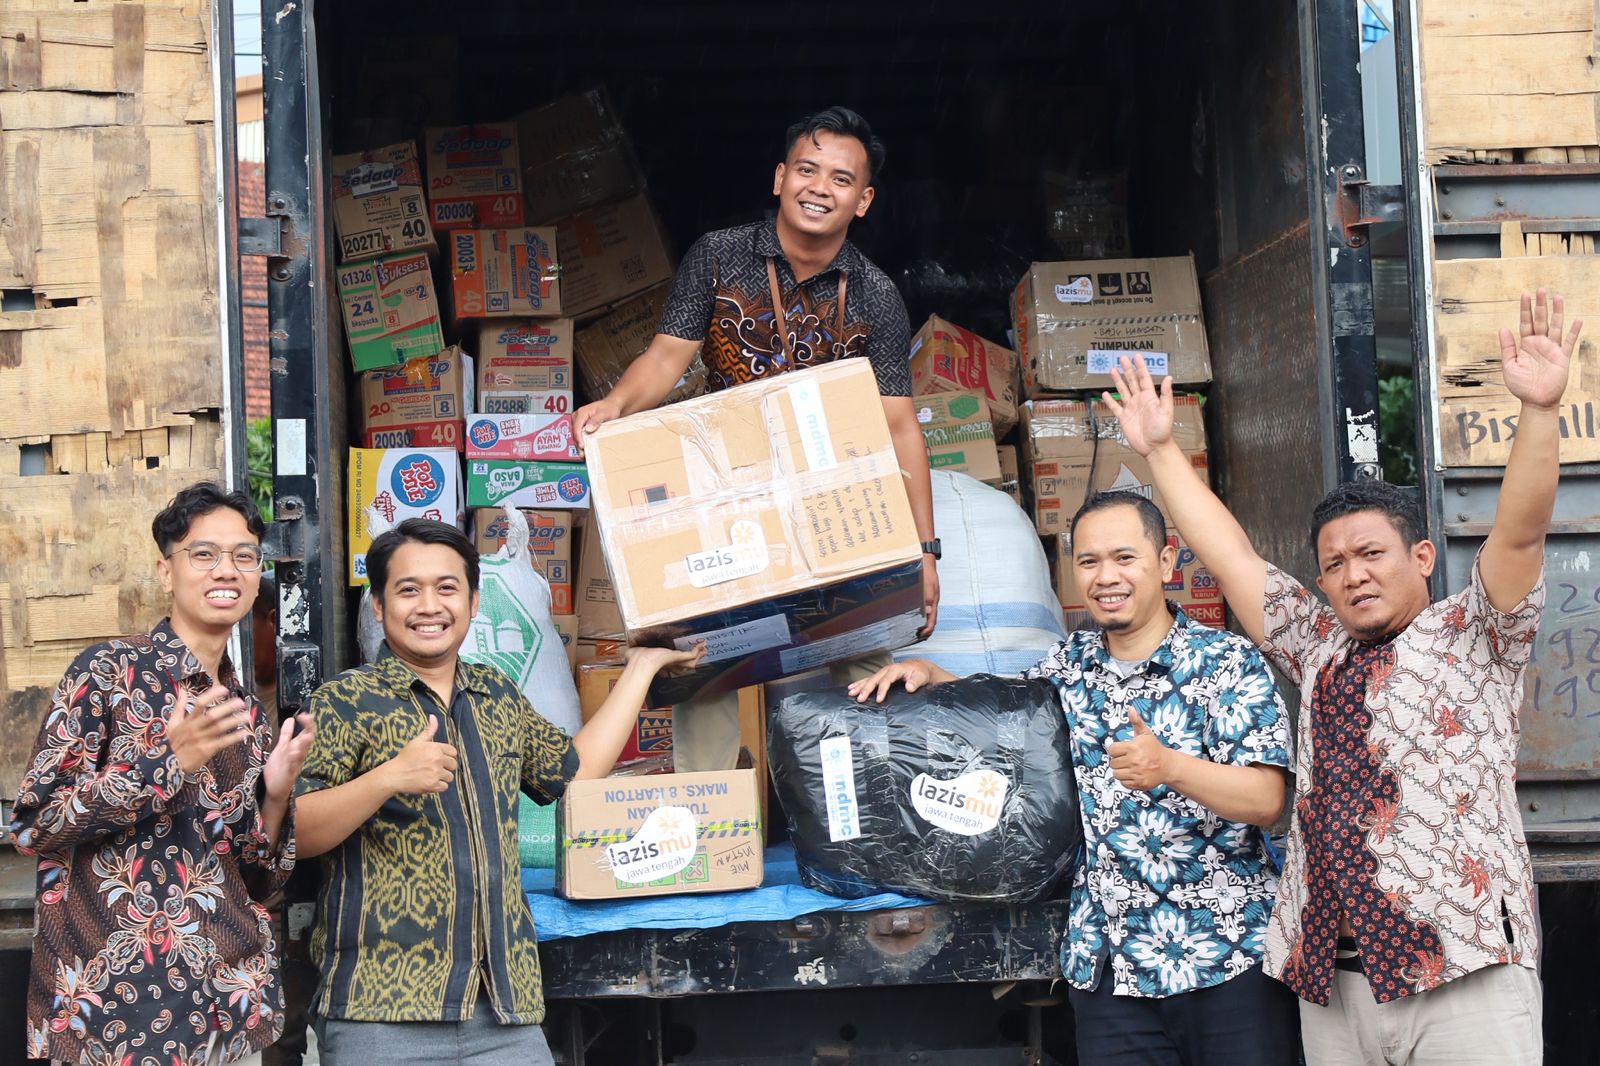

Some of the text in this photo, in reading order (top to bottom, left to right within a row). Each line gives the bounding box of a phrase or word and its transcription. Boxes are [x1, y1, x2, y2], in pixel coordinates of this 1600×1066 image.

[502, 176, 510, 186] 8
[407, 202, 418, 214] 8
[437, 203, 473, 220] 20030
[492, 196, 516, 215] 40
[402, 219, 426, 239] 40
[344, 232, 382, 255] 20277
[342, 269, 372, 286] 61326
[416, 285, 427, 299] 2
[1056, 285, 1092, 296] lazismu
[463, 290, 482, 312] 40
[491, 298, 502, 306] 8
[351, 301, 374, 316] 24
[388, 315, 395, 324] 8
[1090, 340, 1154, 350] TUMPUKAN
[554, 373, 564, 384] 9
[369, 402, 390, 418] 20
[440, 401, 450, 412] 8
[488, 400, 524, 413] 62988
[544, 395, 568, 413] 40
[473, 424, 491, 438] POP
[500, 419, 520, 429] SNEK
[432, 423, 456, 444] 40
[478, 430, 496, 444] MIE
[502, 427, 520, 438] TIME
[536, 434, 560, 444] AYAM
[806, 413, 829, 467] mdmc
[410, 459, 437, 496] POP
[494, 471, 520, 481] BASO
[400, 468, 424, 502] MIE
[535, 484, 556, 495] TIME
[560, 478, 580, 491] MIE
[566, 484, 584, 498] POP
[1045, 483, 1051, 491] 7
[536, 492, 556, 503] SNEK
[358, 558, 366, 576] 24
[552, 566, 562, 578] 8
[604, 782, 728, 802] MAKS. 8 KARTON
[918, 776, 1000, 819] lazismu
[834, 773, 852, 838] mdmc
[924, 804, 984, 830] jawa tengah
[609, 832, 692, 868] lazismu
[626, 856, 686, 879] jawa tengah
[730, 861, 750, 875] MIE
